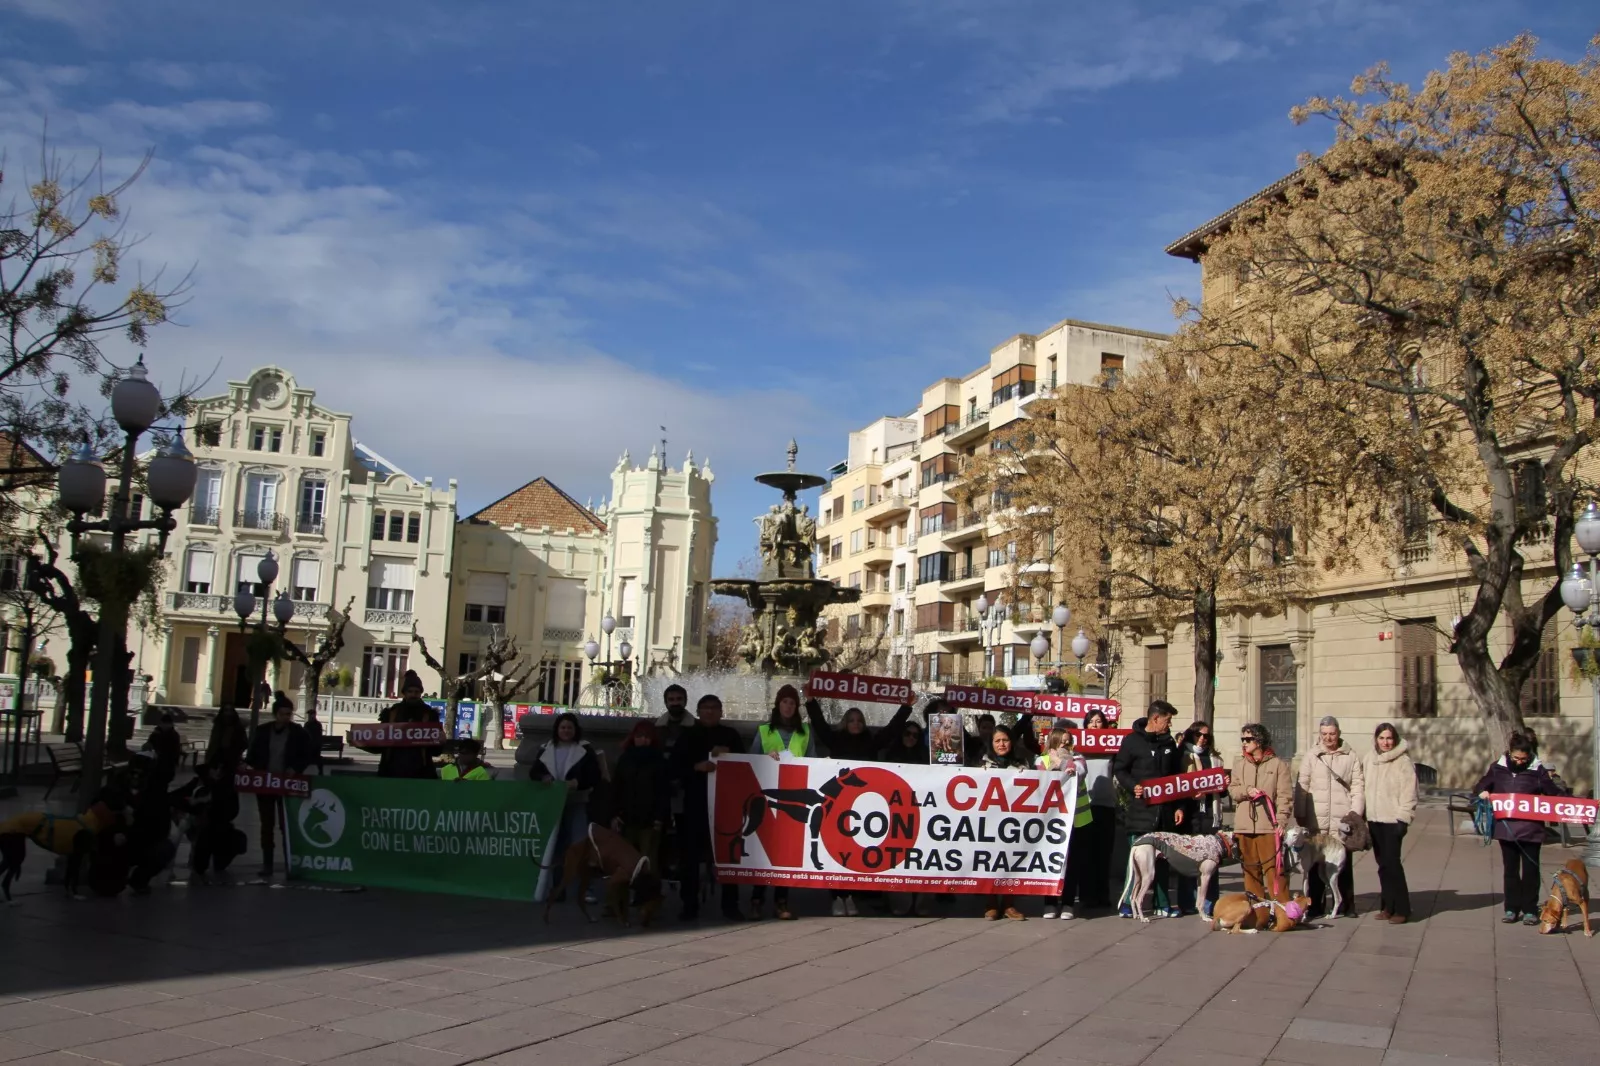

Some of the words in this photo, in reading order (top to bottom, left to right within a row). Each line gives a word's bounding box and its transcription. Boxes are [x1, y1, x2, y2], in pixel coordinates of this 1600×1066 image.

[812, 677, 835, 691] no
[838, 680, 848, 692] a
[852, 676, 868, 694] la
[872, 683, 909, 698] caza
[947, 690, 966, 702] no
[970, 692, 979, 703] a
[982, 689, 996, 705] la
[999, 695, 1032, 709] caza
[1055, 701, 1064, 712] a
[1067, 698, 1080, 713] la
[352, 729, 373, 740] no
[376, 729, 385, 740] a
[389, 725, 402, 740] la
[406, 727, 439, 740] caza
[1081, 730, 1096, 746] la
[1099, 734, 1125, 747] caz
[234, 774, 250, 786] no
[253, 775, 263, 787] a
[266, 773, 281, 788] la
[1143, 785, 1162, 798] no
[1165, 782, 1173, 794] a
[1176, 777, 1190, 792] la
[1193, 773, 1224, 789] caza
[889, 790, 903, 806] A
[911, 791, 938, 808] LA
[946, 775, 1069, 814] CAZA
[714, 760, 919, 873] NO
[1492, 799, 1515, 812] no
[1518, 800, 1529, 812] a
[1533, 797, 1551, 814] la
[1555, 803, 1597, 817] caza
[361, 806, 430, 831] PARTIDO
[434, 810, 541, 834] ANIMALISTA
[837, 810, 914, 839] CON
[927, 813, 1067, 844] GALGOS
[361, 831, 390, 851] CON
[393, 833, 411, 852] EL
[413, 835, 460, 854] MEDIO
[465, 836, 541, 858] AMBIENTE
[290, 854, 353, 872] PACMA
[839, 852, 852, 867] Y
[861, 846, 963, 871] OTRAS
[973, 850, 1066, 874] RAZAS
[792, 872, 808, 880] está
[874, 876, 903, 885] derecho
[905, 877, 923, 885] tiene
